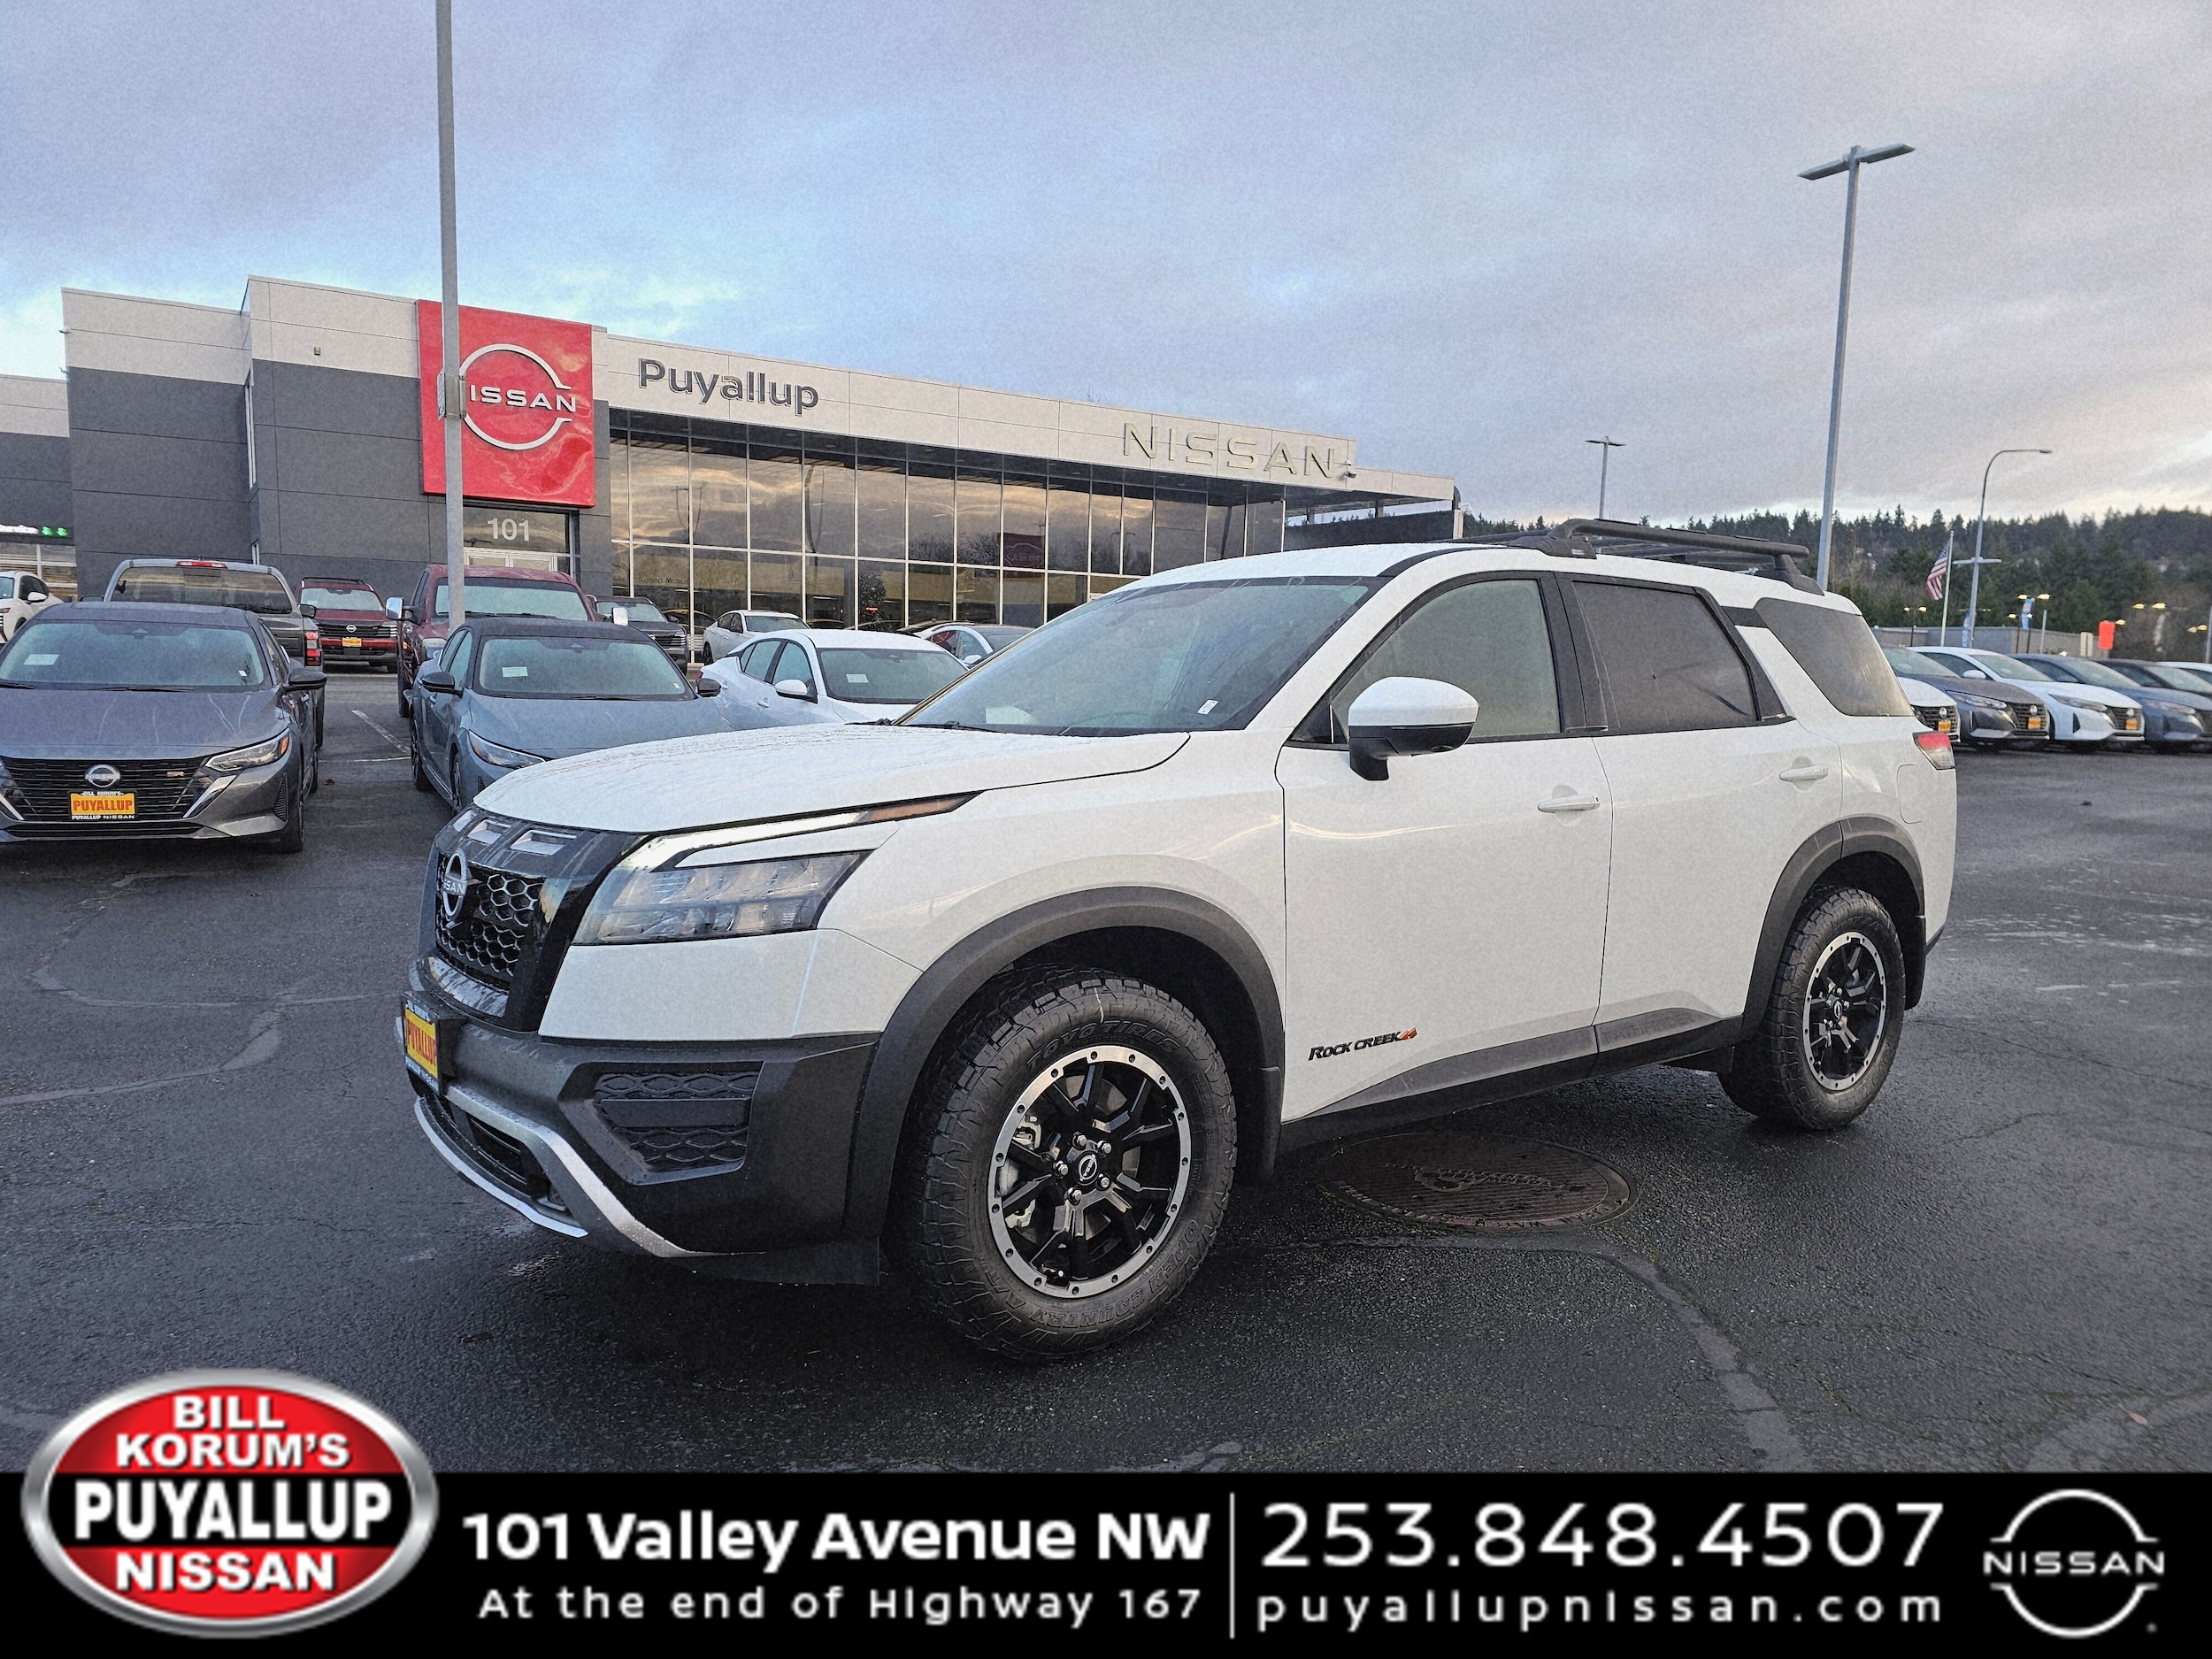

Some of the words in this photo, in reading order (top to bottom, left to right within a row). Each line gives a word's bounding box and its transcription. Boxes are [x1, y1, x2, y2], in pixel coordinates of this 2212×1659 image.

[469, 384, 577, 414] ISSAN
[639, 358, 819, 416] Puyallup
[1123, 423, 1335, 478] NISSAN
[488, 518, 529, 541] 101
[73, 800, 133, 811] PUYALLUP
[1026, 1023, 1097, 1071] TOYO
[1102, 1020, 1180, 1053] TIRES
[1309, 1041, 1353, 1061] ROCK
[1354, 1031, 1401, 1051] CREEK
[1029, 1287, 1146, 1328] COUNTRY
